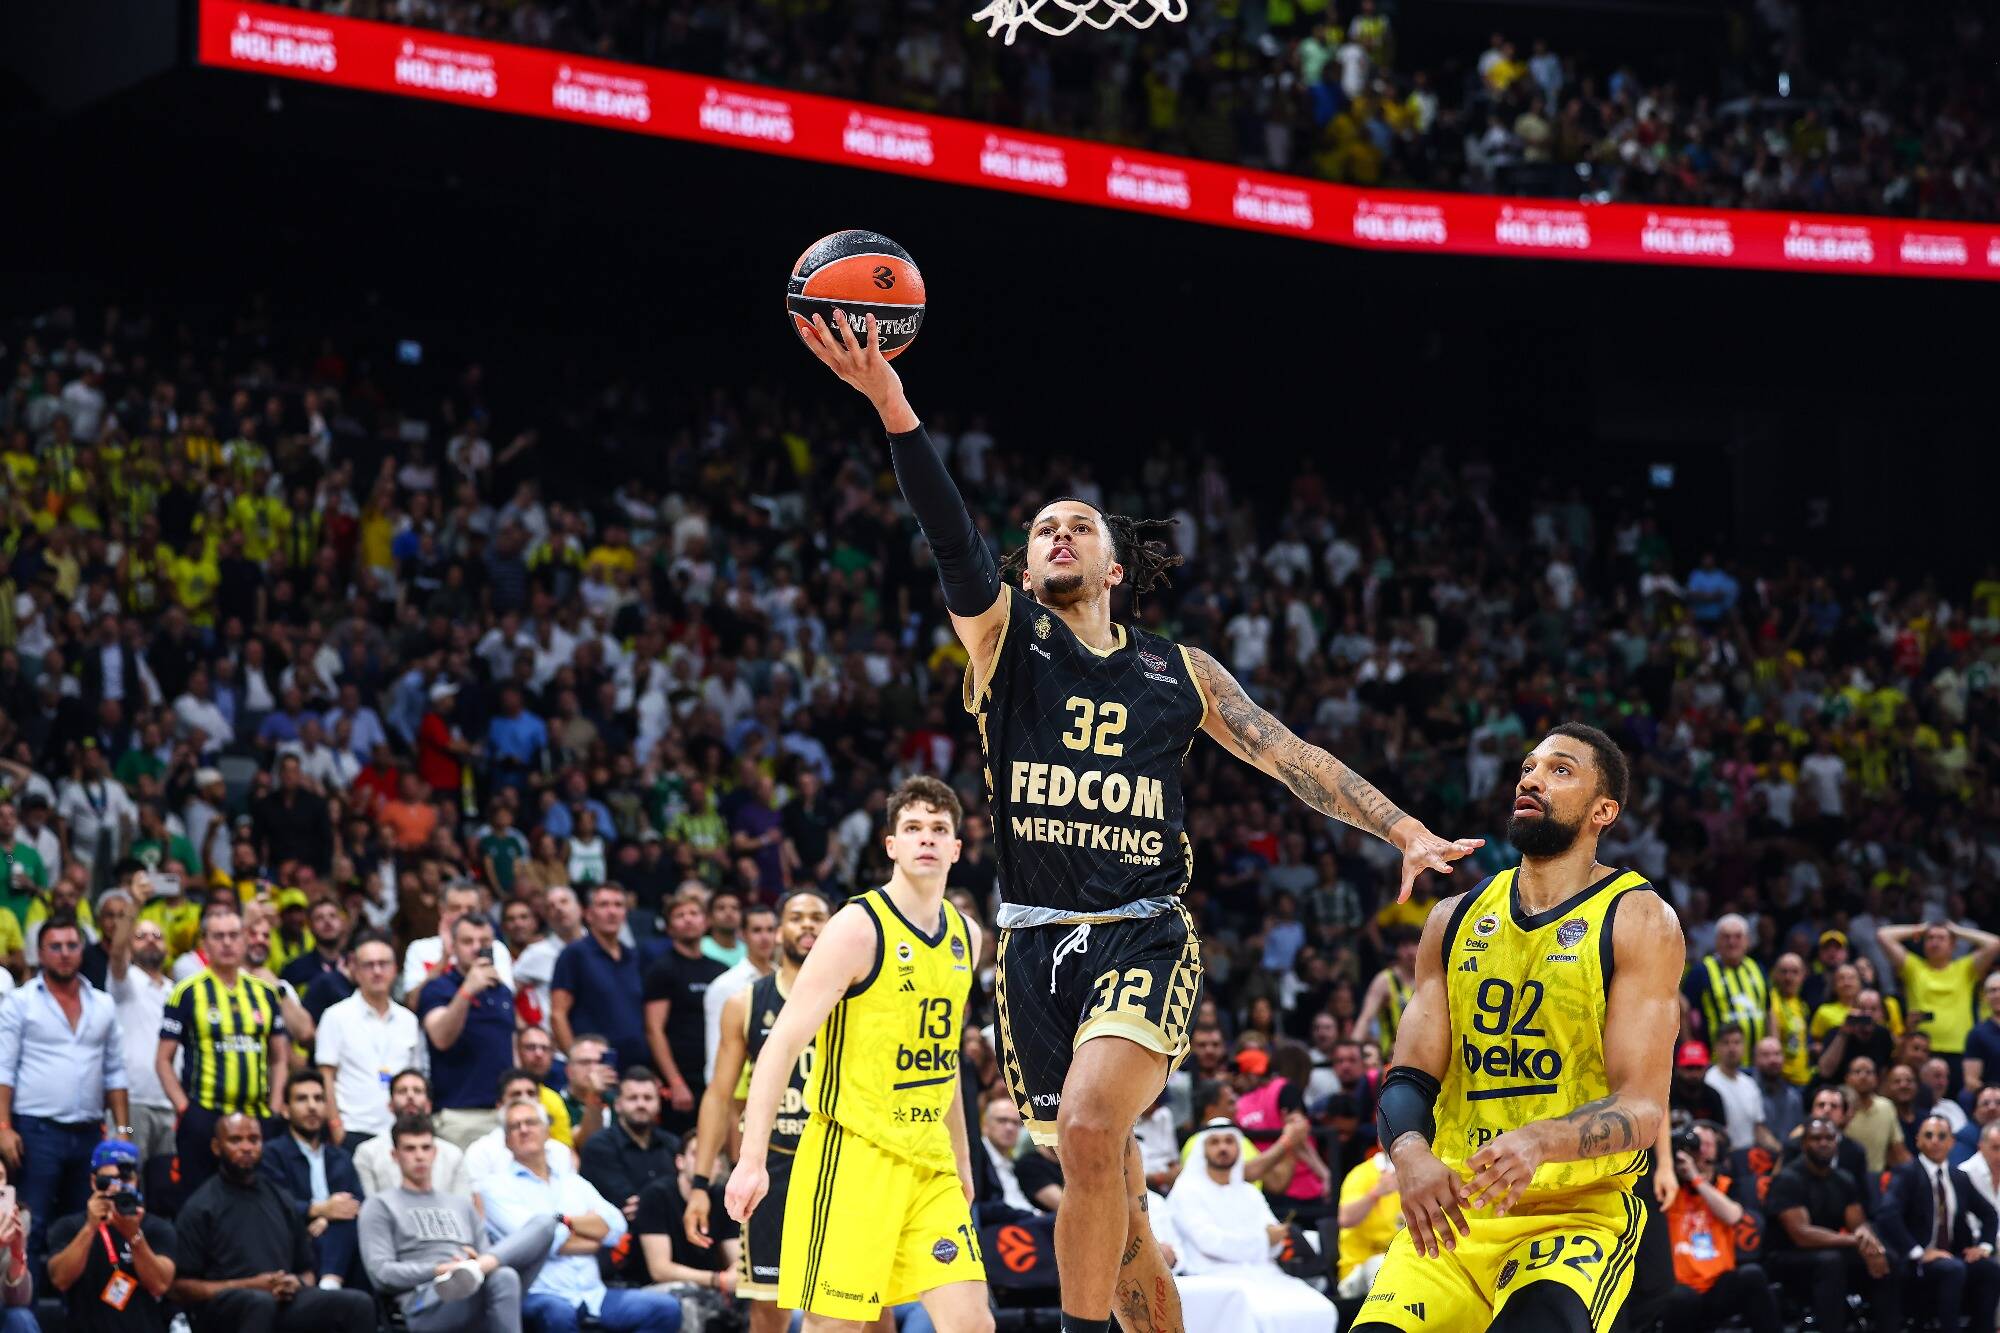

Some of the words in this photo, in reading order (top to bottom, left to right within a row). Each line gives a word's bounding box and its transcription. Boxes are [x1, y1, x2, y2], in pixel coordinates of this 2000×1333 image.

[230, 30, 337, 72] HOLIDAYS
[395, 55, 497, 98] HOLIDAYS
[552, 81, 650, 122] HOLIDAYS
[699, 104, 794, 142] HOLIDAYS
[842, 126, 935, 166] HOLIDAYS
[980, 149, 1067, 187] HOLIDAYS
[1107, 171, 1191, 209] HOLIDAYS
[1353, 211, 1447, 244] HOLIDAYS
[1062, 693, 1128, 757] 32
[1010, 760, 1165, 820] FEDCOM
[1119, 853, 1161, 866] .news
[1465, 938, 1488, 948] beko
[1090, 967, 1153, 1018] 32
[1473, 977, 1546, 1037] 92
[918, 997, 952, 1039] 13
[1462, 1034, 1562, 1080] beko
[1526, 1235, 1603, 1282] 92
